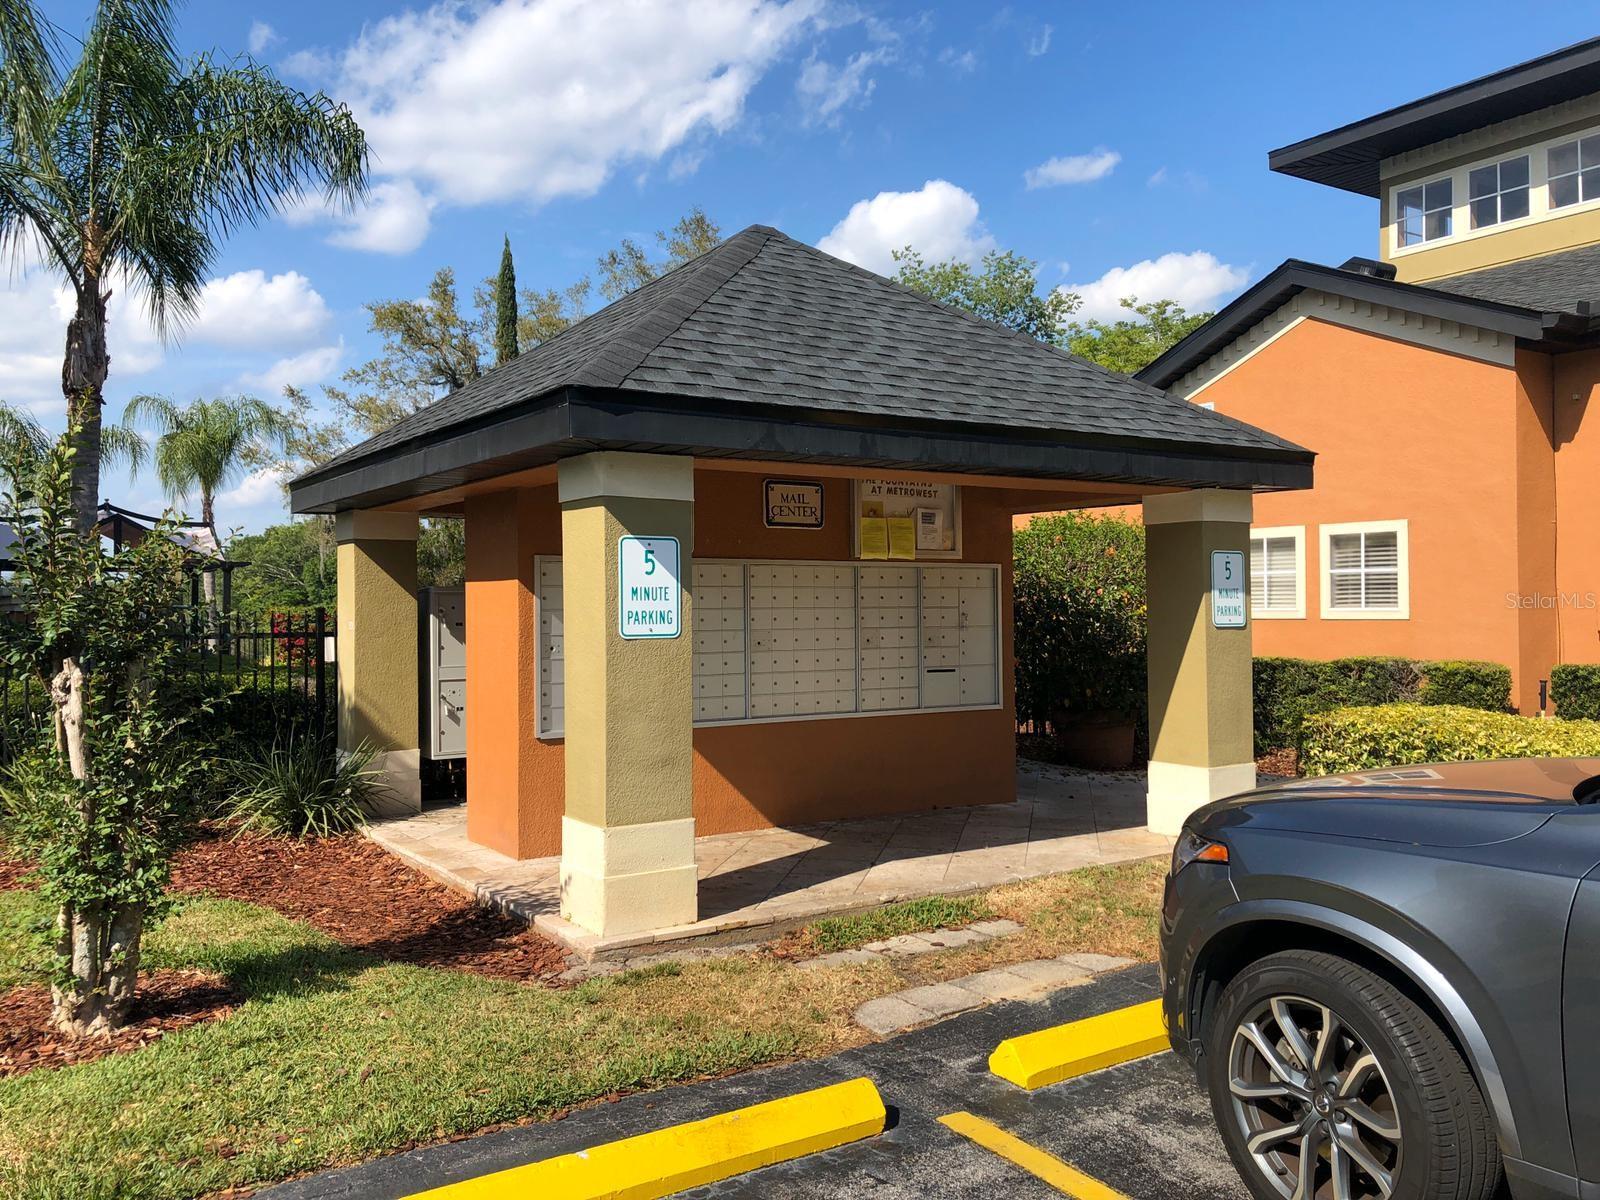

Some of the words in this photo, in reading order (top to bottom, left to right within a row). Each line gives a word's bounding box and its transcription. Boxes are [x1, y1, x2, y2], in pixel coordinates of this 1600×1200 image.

[871, 486, 882, 494] AT
[886, 486, 938, 498] METROWEST
[780, 493, 809, 504] MAIL
[771, 505, 817, 517] CENTER
[644, 549, 656, 575] 5
[1225, 561, 1232, 580] 5
[631, 586, 670, 601] MINUTE
[1218, 588, 1239, 600] MINUTE
[1216, 605, 1242, 617] PARKING
[627, 610, 673, 625] PARKING
